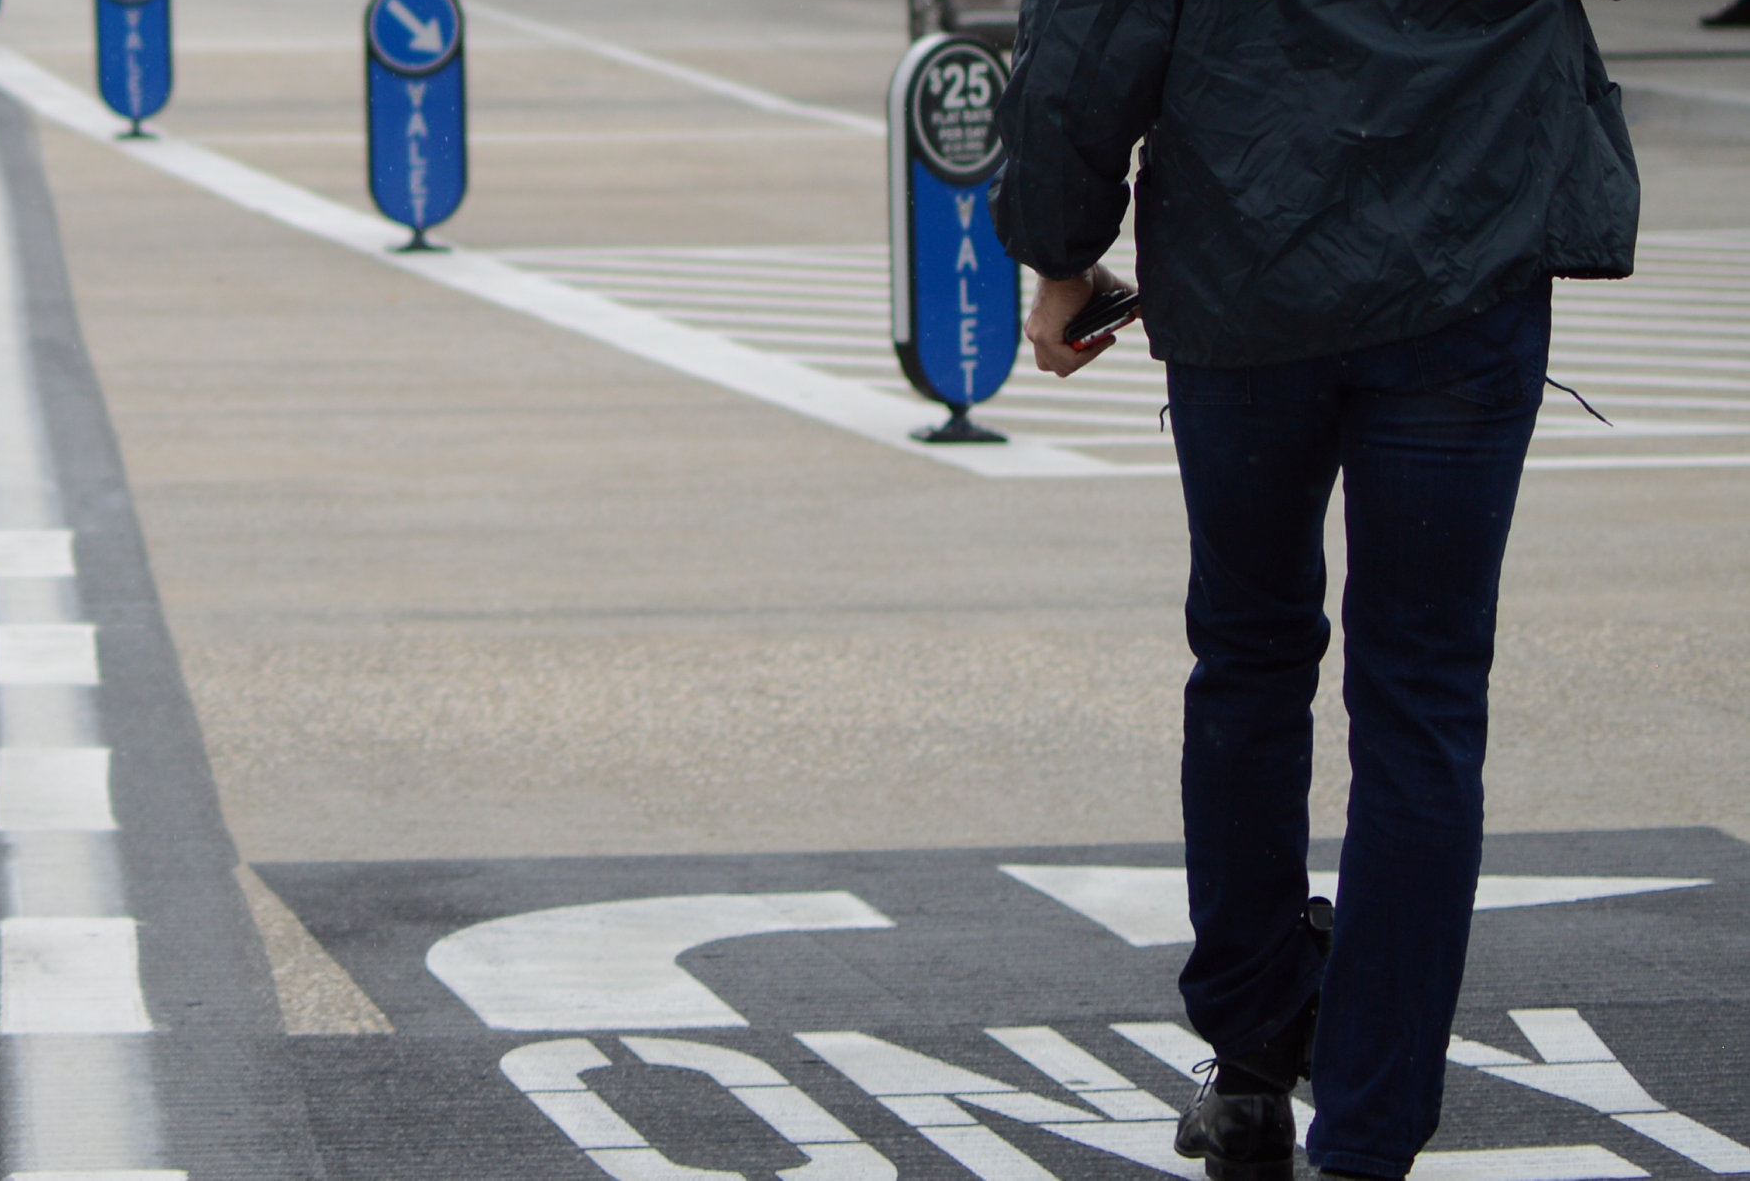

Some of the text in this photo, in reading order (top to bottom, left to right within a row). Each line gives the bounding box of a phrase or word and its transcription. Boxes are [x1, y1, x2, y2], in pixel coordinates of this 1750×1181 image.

[125, 8, 144, 117] VALET
[929, 62, 992, 108] $25
[932, 110, 961, 124] FLAT
[406, 83, 429, 229] VALET
[955, 194, 979, 397] VALET
[498, 1007, 1750, 1181] ONLY
